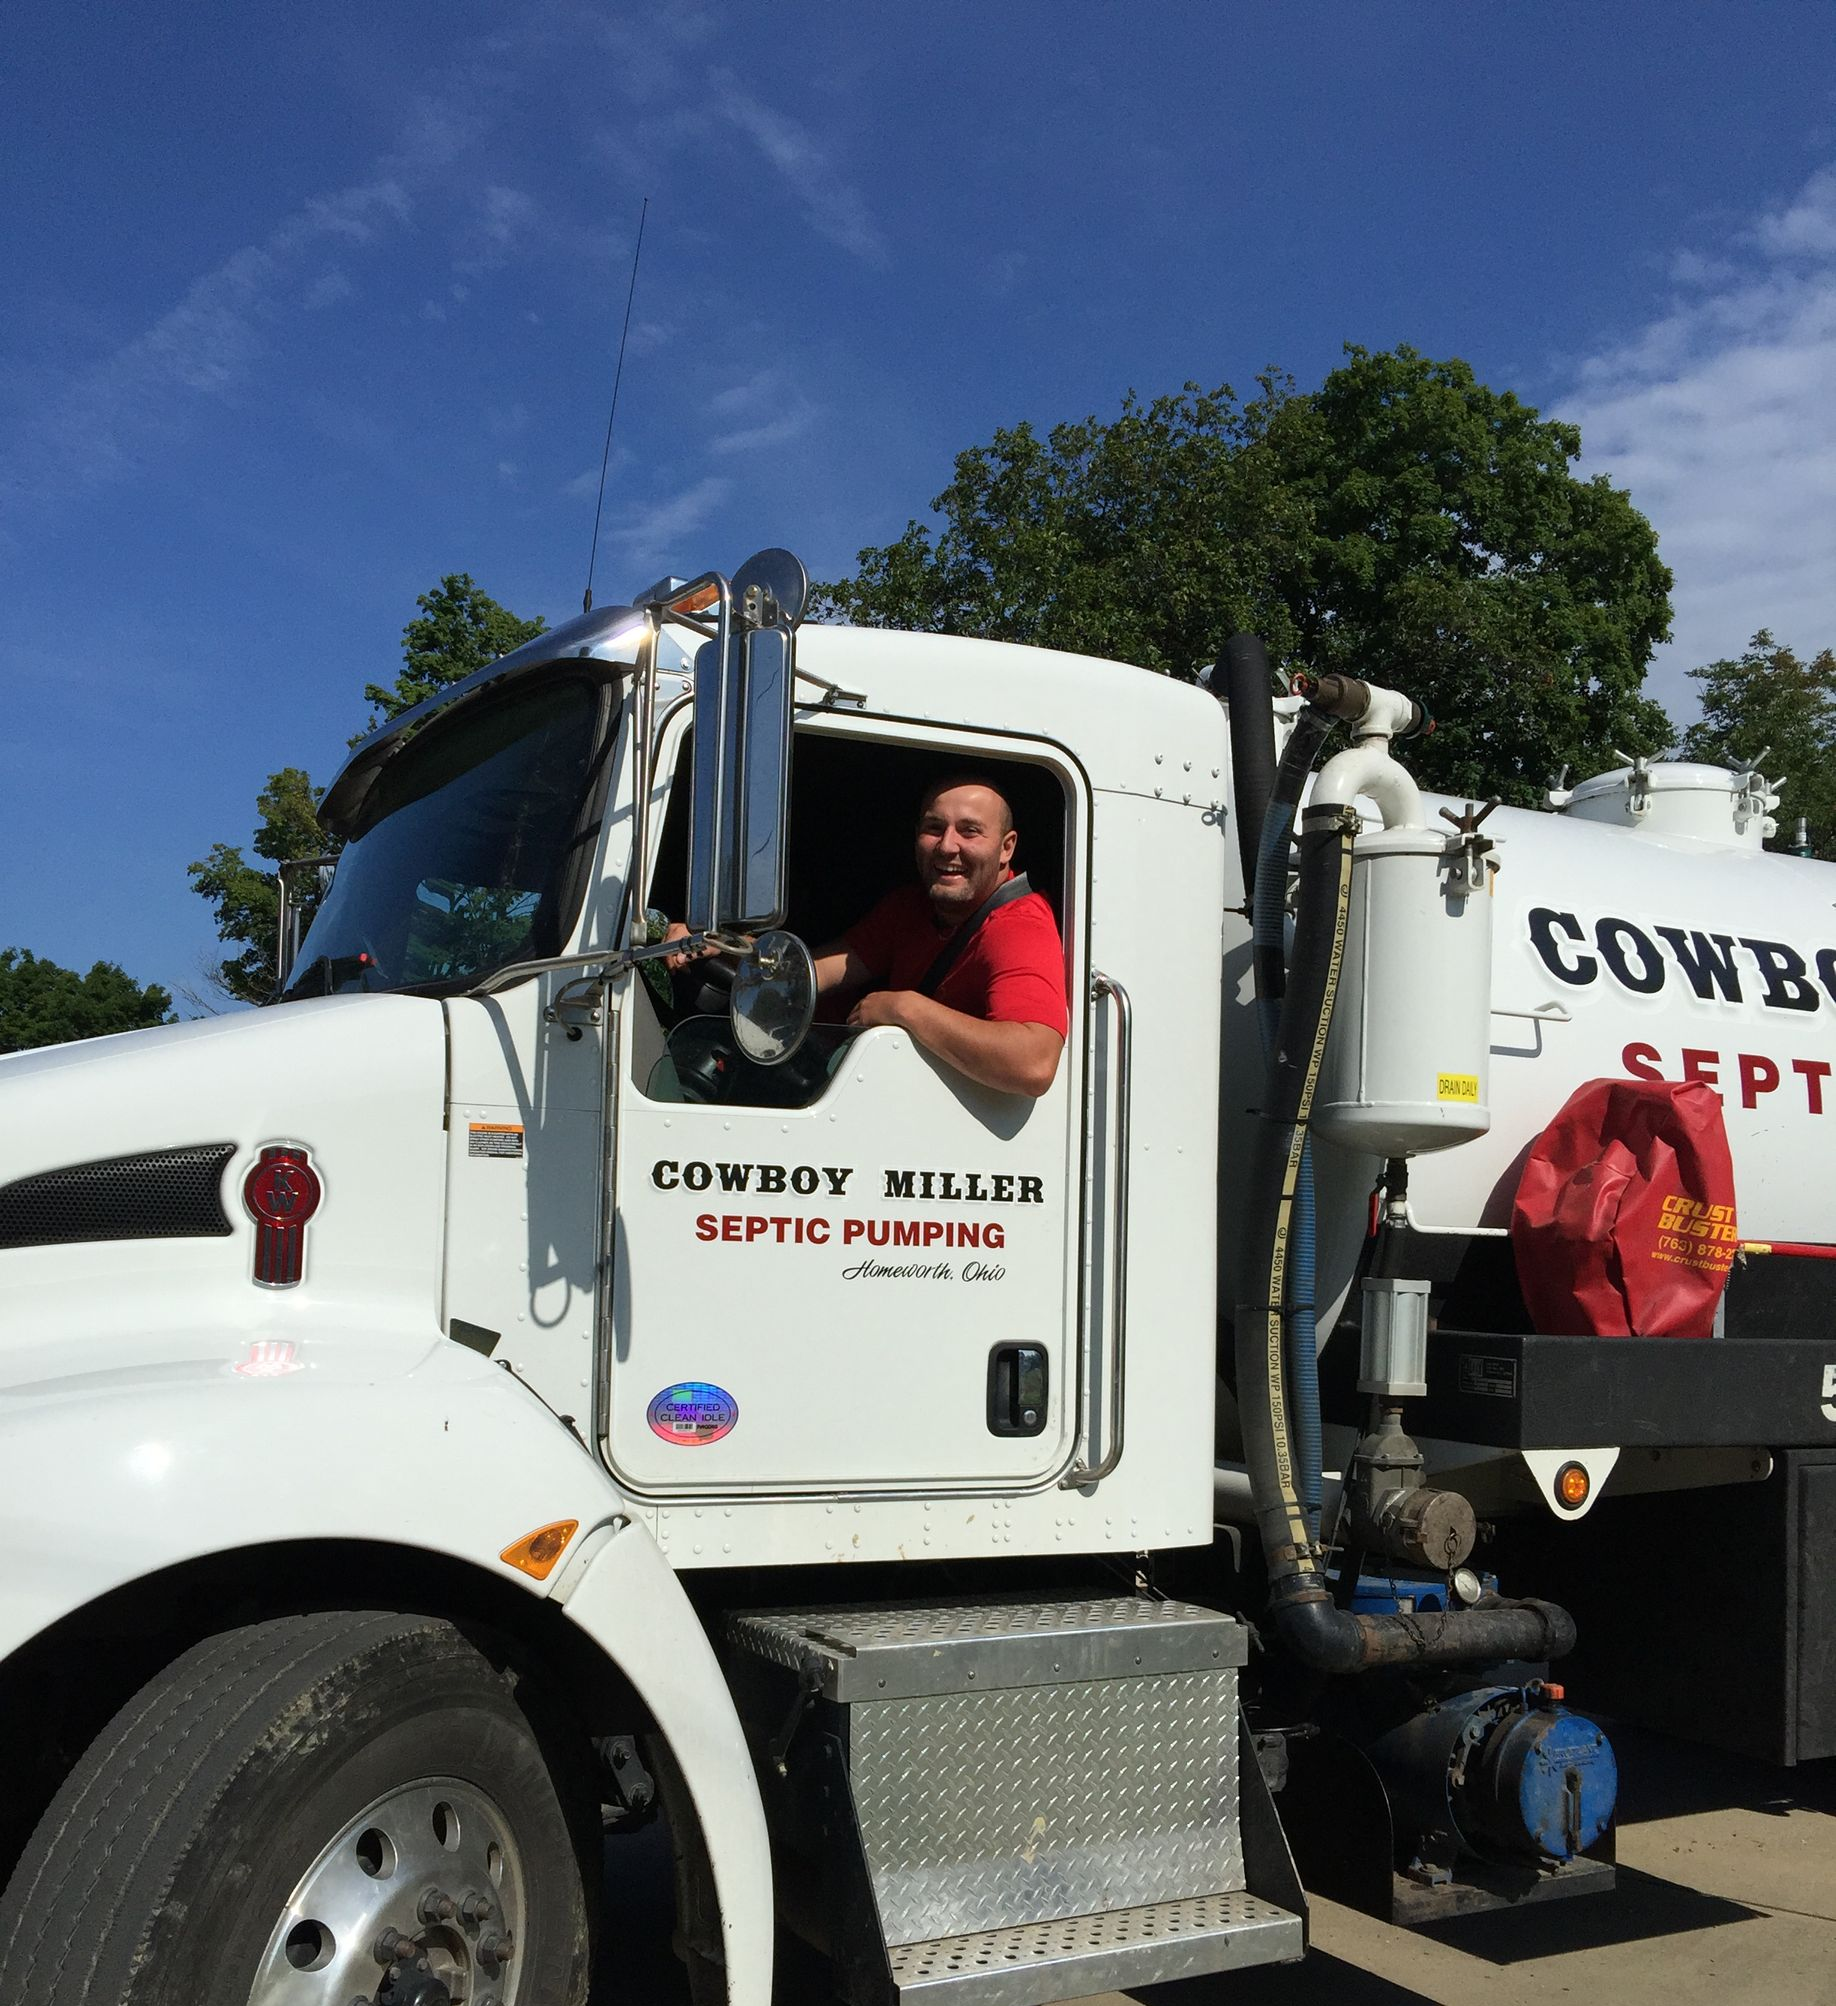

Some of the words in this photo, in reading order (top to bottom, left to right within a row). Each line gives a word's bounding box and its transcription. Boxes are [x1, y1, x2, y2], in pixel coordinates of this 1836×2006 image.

[1336, 906, 1347, 936] 4450
[1329, 938, 1345, 986] WATER
[1316, 989, 1335, 1045] SUCTION
[1312, 1048, 1323, 1068] WP
[1300, 1072, 1317, 1111] 150PSI
[1439, 1079, 1461, 1095] DRAIN
[1461, 1080, 1478, 1096] DAILY
[651, 1159, 854, 1196] COWBOY
[884, 1169, 1044, 1203] MILLER
[1662, 1195, 1735, 1223] CRUST
[695, 1213, 831, 1244] SEPTIC
[843, 1219, 1005, 1249] PUMPING
[1658, 1235, 1693, 1255] (763)
[962, 1261, 1006, 1282] Ohio
[1273, 1246, 1284, 1272] 4450
[1269, 1319, 1280, 1370] SUCTION
[1270, 1374, 1281, 1392] WP
[660, 1413, 697, 1422] CLEAN
[701, 1414, 726, 1422] IDLE
[666, 1403, 720, 1412] CERTIFIED
[1271, 1395, 1285, 1432] 150PSI
[1276, 1436, 1291, 1489] 10.35BAR
